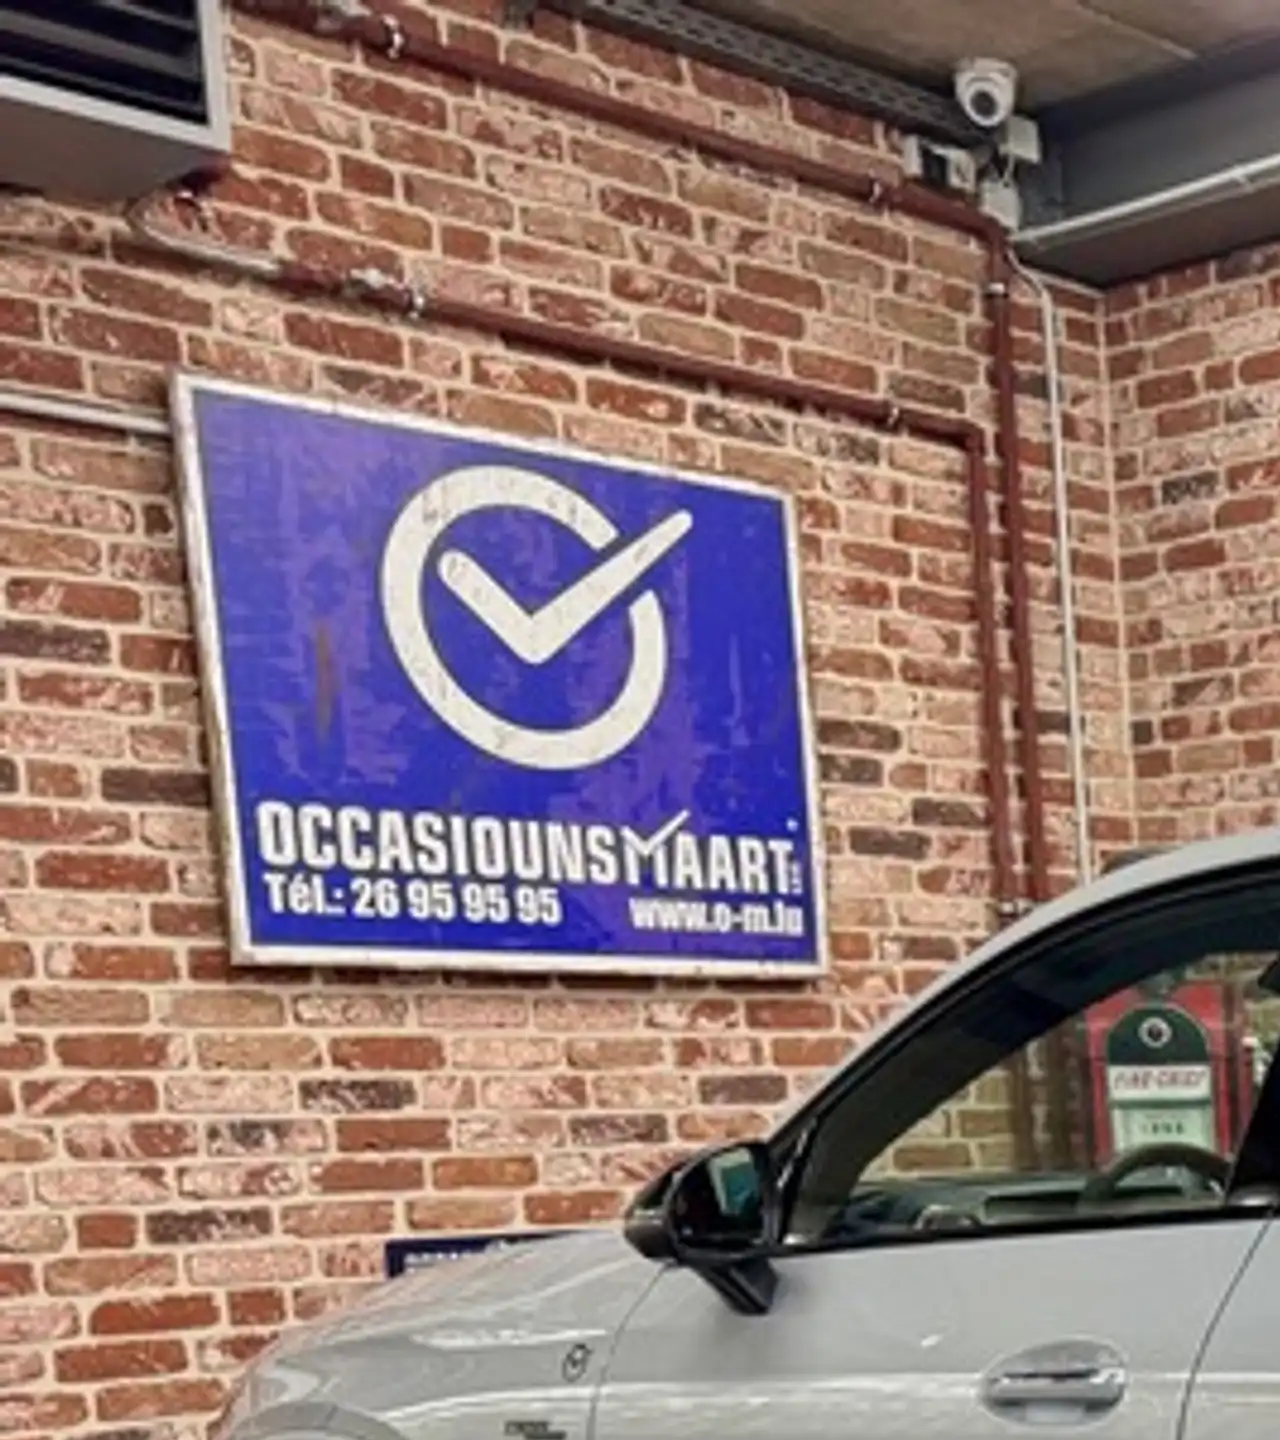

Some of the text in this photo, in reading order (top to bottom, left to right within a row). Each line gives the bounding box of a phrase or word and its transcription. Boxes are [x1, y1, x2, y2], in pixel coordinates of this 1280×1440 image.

[351, 877, 400, 919] 26
[407, 881, 456, 922] 95
[463, 883, 510, 924] 95
[516, 886, 563, 928] 95
[629, 896, 804, 937] www.o-m.lu
